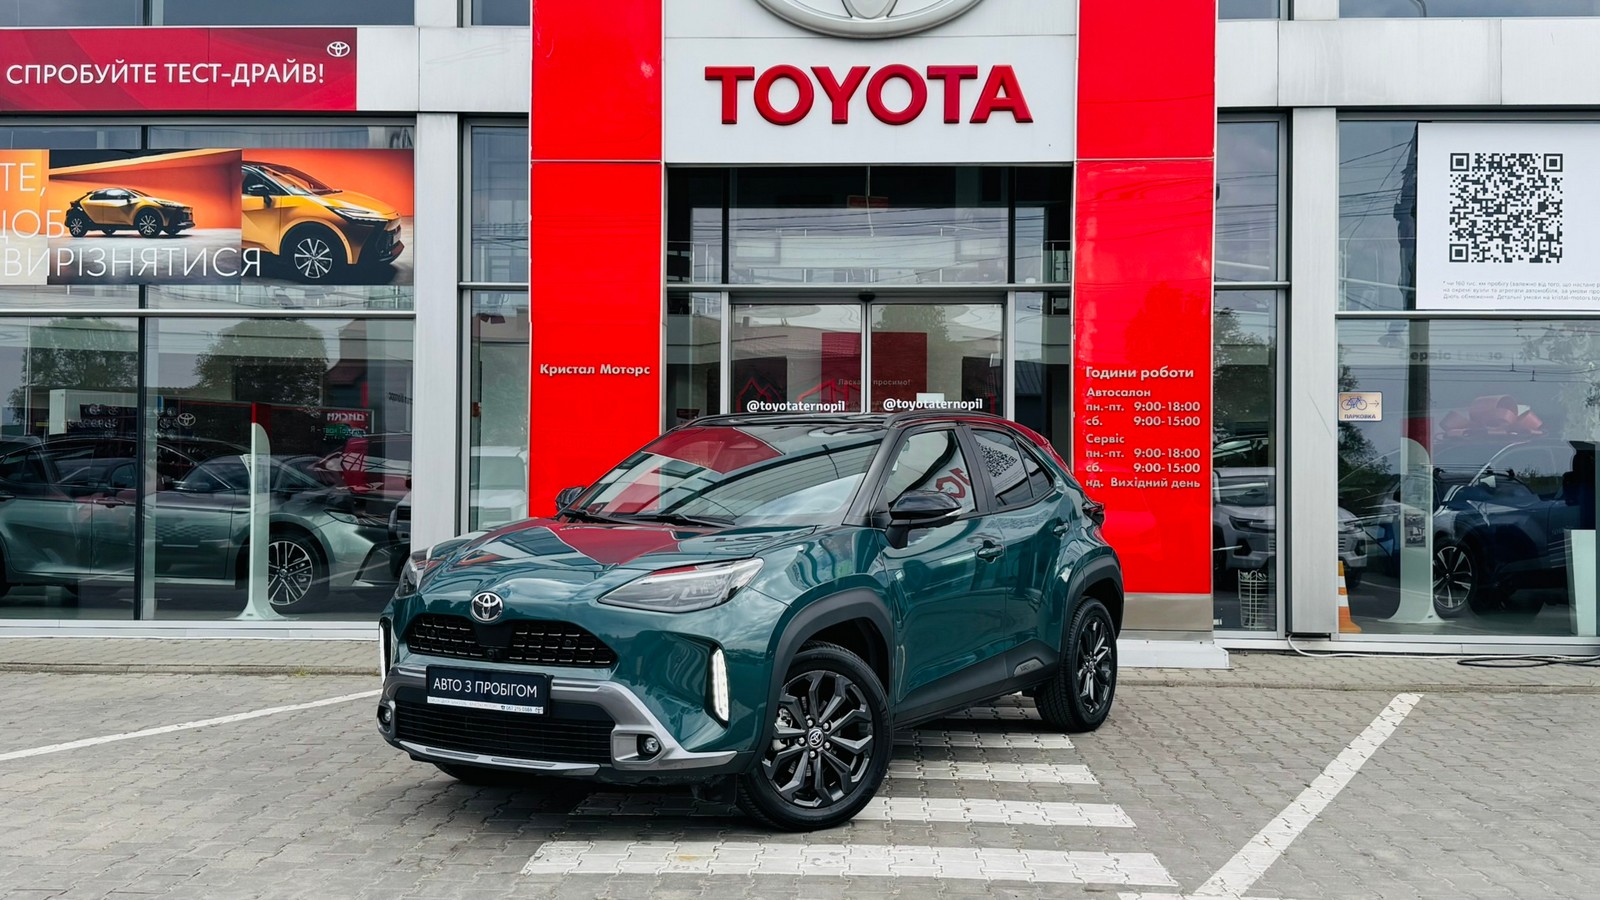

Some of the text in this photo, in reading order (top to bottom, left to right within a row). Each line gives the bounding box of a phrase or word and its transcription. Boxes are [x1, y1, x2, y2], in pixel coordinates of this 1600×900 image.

[6, 58, 324, 88] СПРОБУЙТЕ ТЕСТ-ДРАЙВ!
[704, 63, 1034, 126] TOYOTA
[4, 247, 261, 277] ВИРІЗНЯТИСЯ
[540, 364, 651, 377] Кристал Моторс
[1085, 365, 1194, 381] Години роботи
[1086, 387, 1151, 397] Автосалон
[746, 399, 846, 413] @toyotaternopil
[882, 398, 983, 412] @toyotaternopil
[1085, 401, 1201, 411] пн.-пт. 9:00-18:00
[1085, 415, 1201, 426] сб. 9:00-15:00
[1085, 433, 1125, 446] Сервіс
[1085, 448, 1201, 458] пн.-пт. 9:00-18:00
[1085, 462, 1201, 473] сб. 9:00-15:00
[1085, 476, 1201, 488] нд. Вихідний день
[433, 677, 462, 692] АВТО
[475, 681, 538, 698] ПРОБІГОМ
